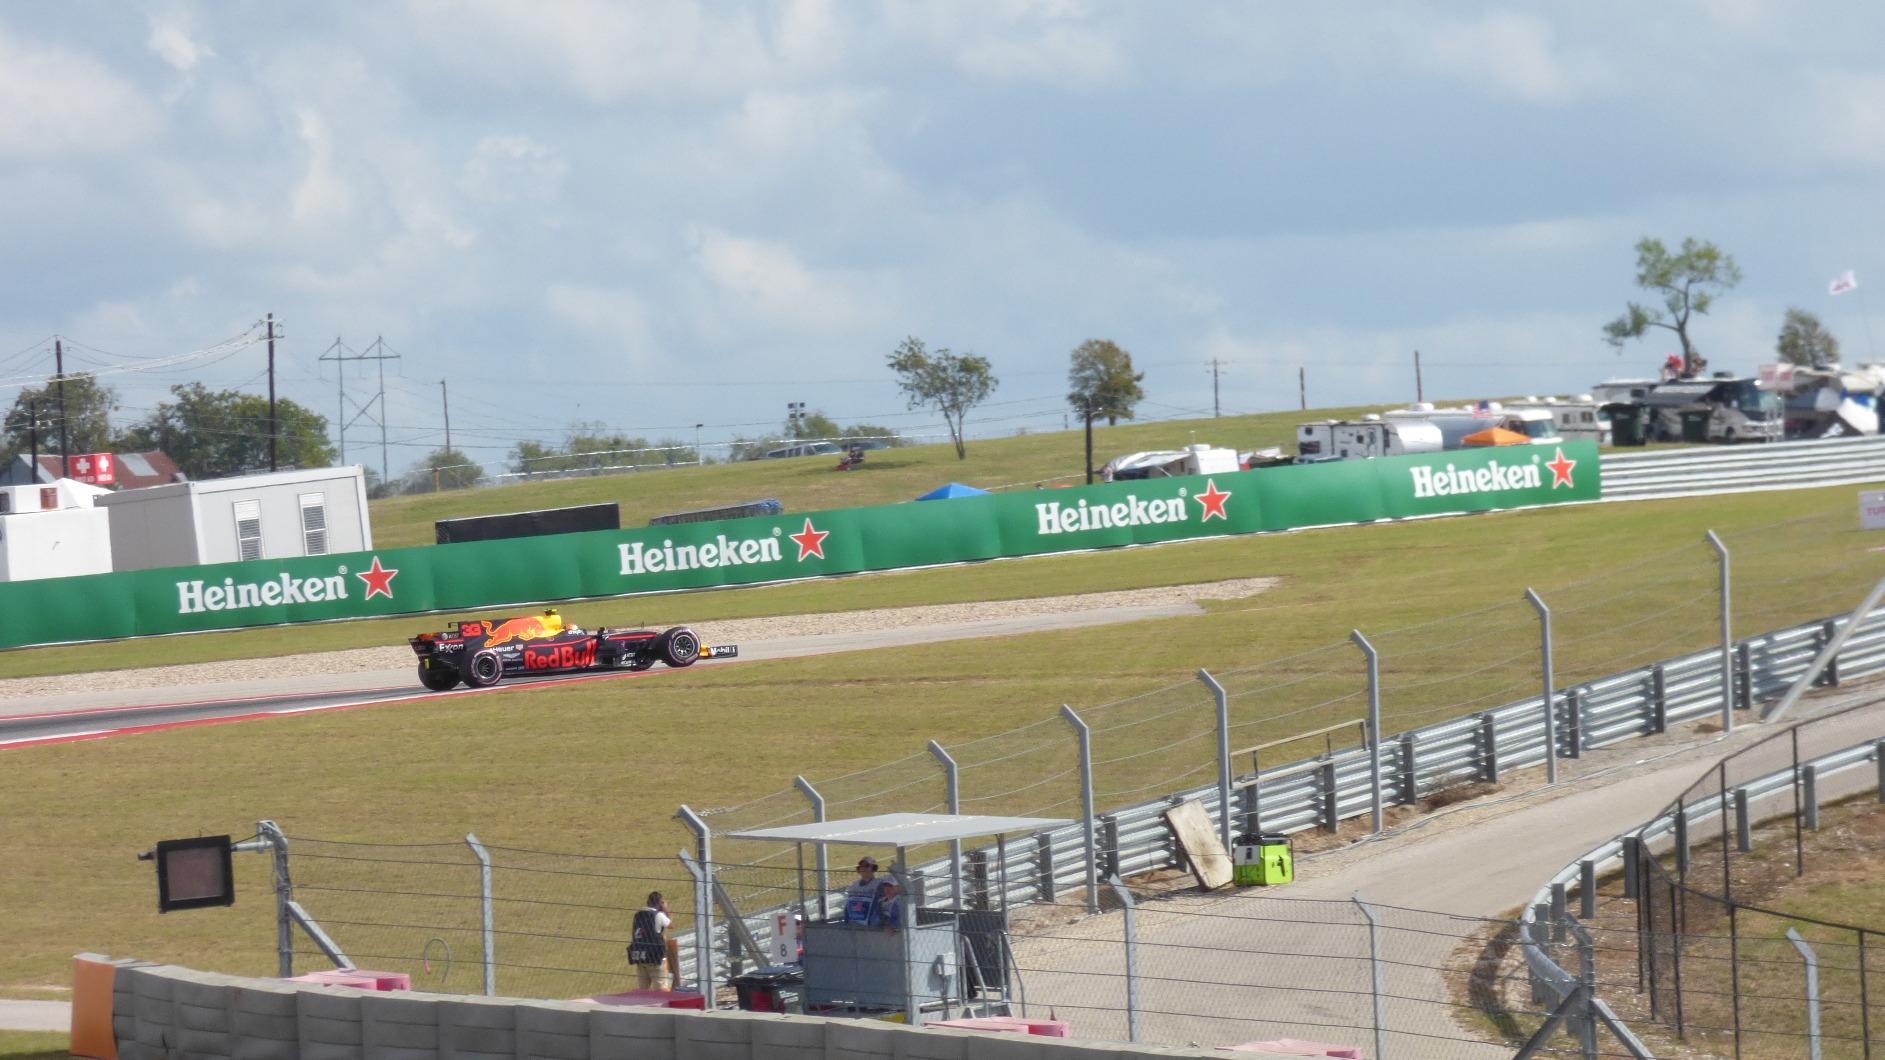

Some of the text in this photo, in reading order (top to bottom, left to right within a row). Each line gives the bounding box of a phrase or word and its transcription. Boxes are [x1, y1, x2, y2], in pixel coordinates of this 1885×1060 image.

[461, 623, 482, 637] 33
[439, 643, 464, 653] Exxon
[524, 648, 560, 672] Red
[561, 639, 598, 669] Bull
[777, 915, 787, 937] F
